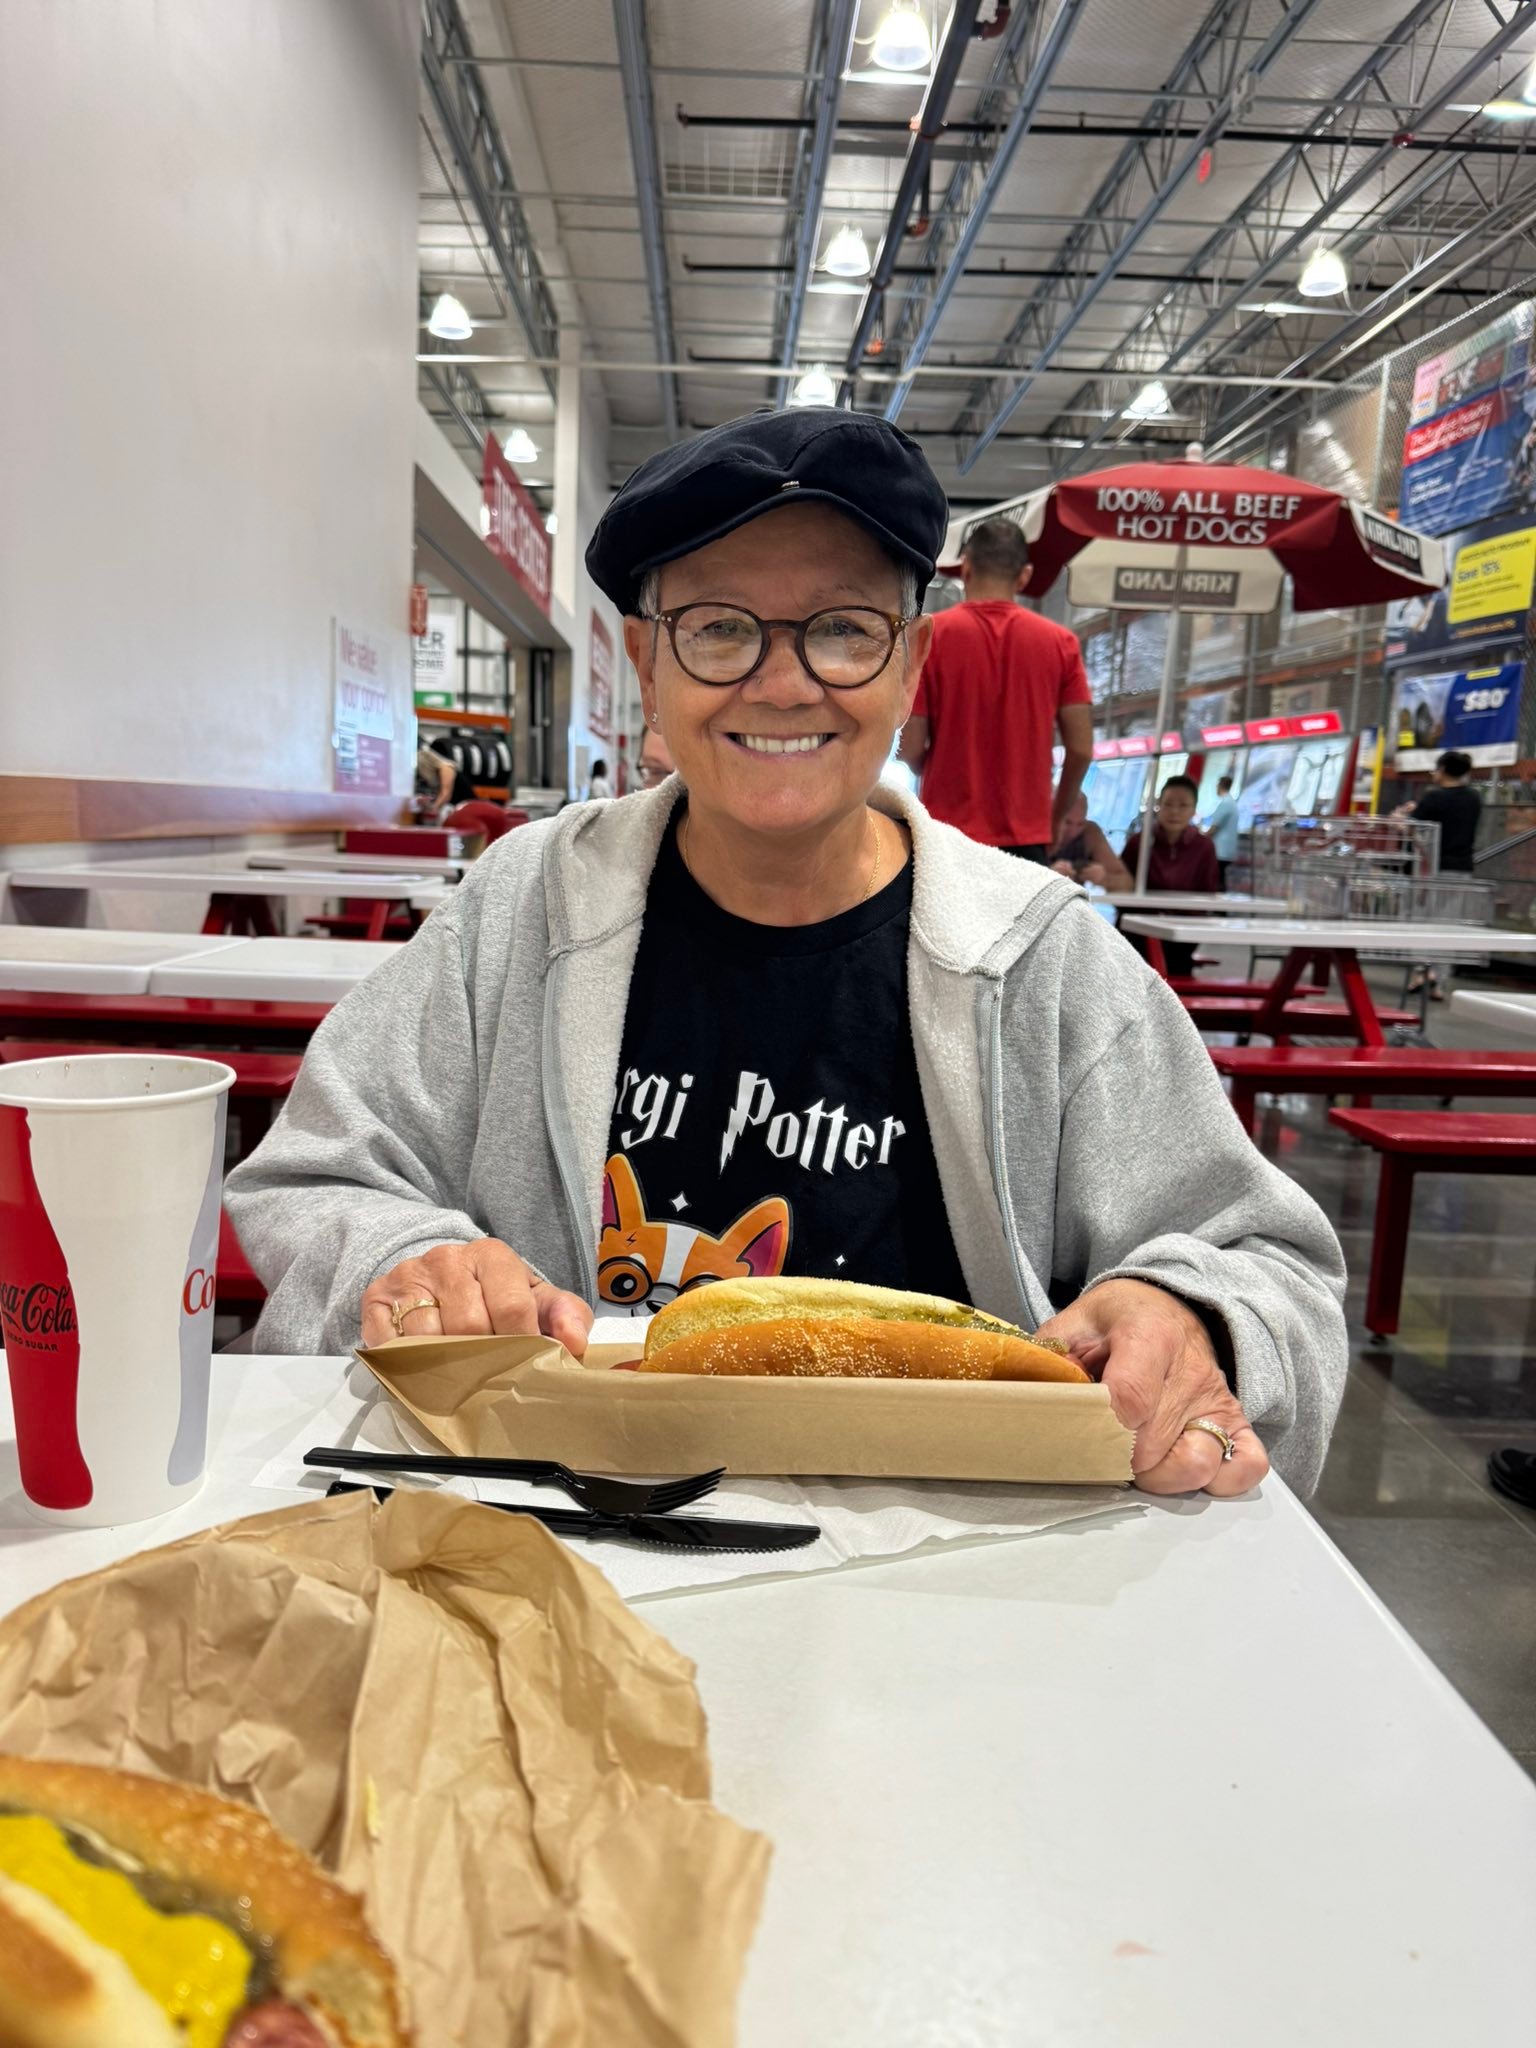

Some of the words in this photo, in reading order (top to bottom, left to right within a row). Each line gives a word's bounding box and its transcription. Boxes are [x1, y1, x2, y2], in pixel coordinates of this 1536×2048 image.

[1097, 487, 1164, 512] 100%
[1171, 490, 1226, 515] ALL
[1233, 493, 1301, 520] BEEF
[1116, 515, 1179, 539] HOT
[1184, 517, 1267, 544] DOGS
[616, 1066, 695, 1150] rgi
[718, 1070, 907, 1177] Potter
[183, 1268, 215, 1315] Co
[25, 1340, 58, 1352] SUGAR
